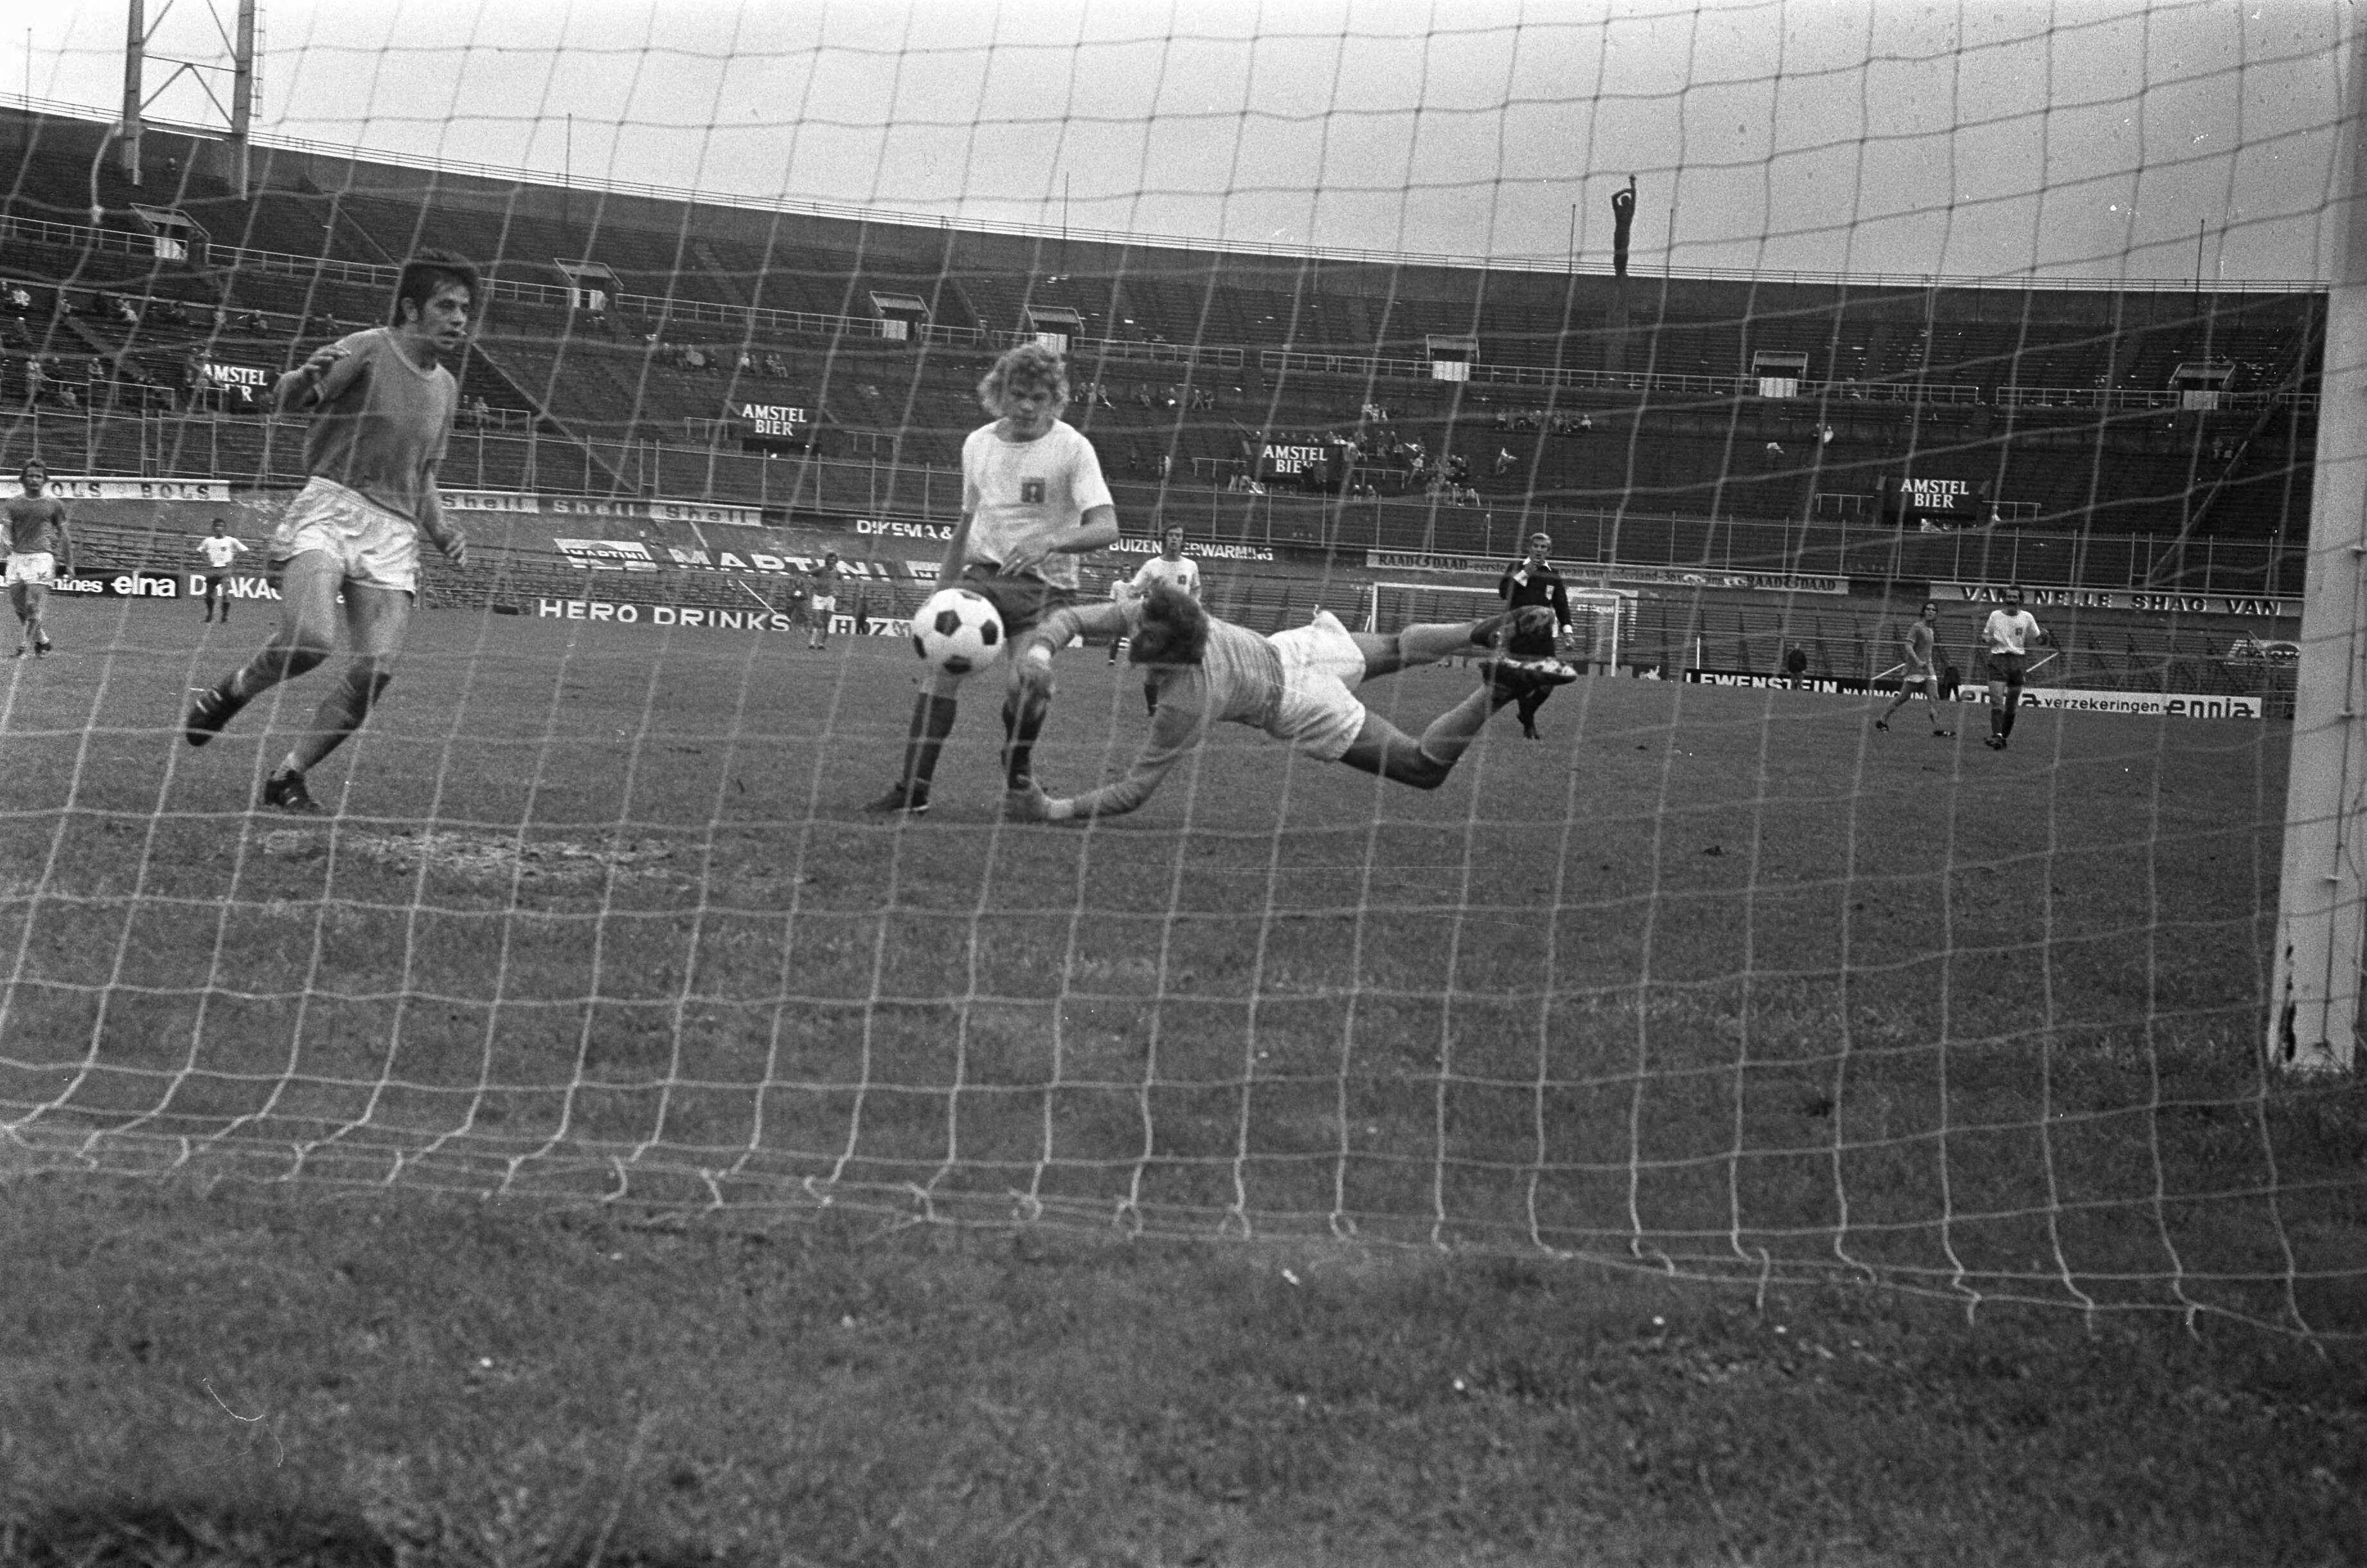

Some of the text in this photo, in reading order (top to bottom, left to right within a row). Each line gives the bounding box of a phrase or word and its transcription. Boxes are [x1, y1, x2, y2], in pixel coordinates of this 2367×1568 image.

[204, 364, 268, 386] AMSTEL
[742, 404, 807, 423] AMSTEL
[755, 419, 794, 436] BIER
[1262, 444, 1328, 461] AMSTEL
[51, 482, 210, 500] OLS BOLS
[1900, 478, 1970, 495] AMSTEL
[442, 495, 523, 512] Shell
[553, 499, 634, 516] Shell
[1914, 493, 1954, 508] BIER
[666, 504, 746, 523] Shell
[940, 525, 952, 540] &
[1109, 538, 1163, 554] BUIZEN
[1181, 542, 1274, 561] ERWARMING
[111, 571, 176, 597] elna
[539, 599, 790, 632] HERO DRINKS
[2226, 598, 2281, 616] VAN
[1686, 672, 1837, 693] LEWENSTEIN
[2044, 697, 2160, 713] verzekeringen
[2163, 697, 2255, 719] ennia
